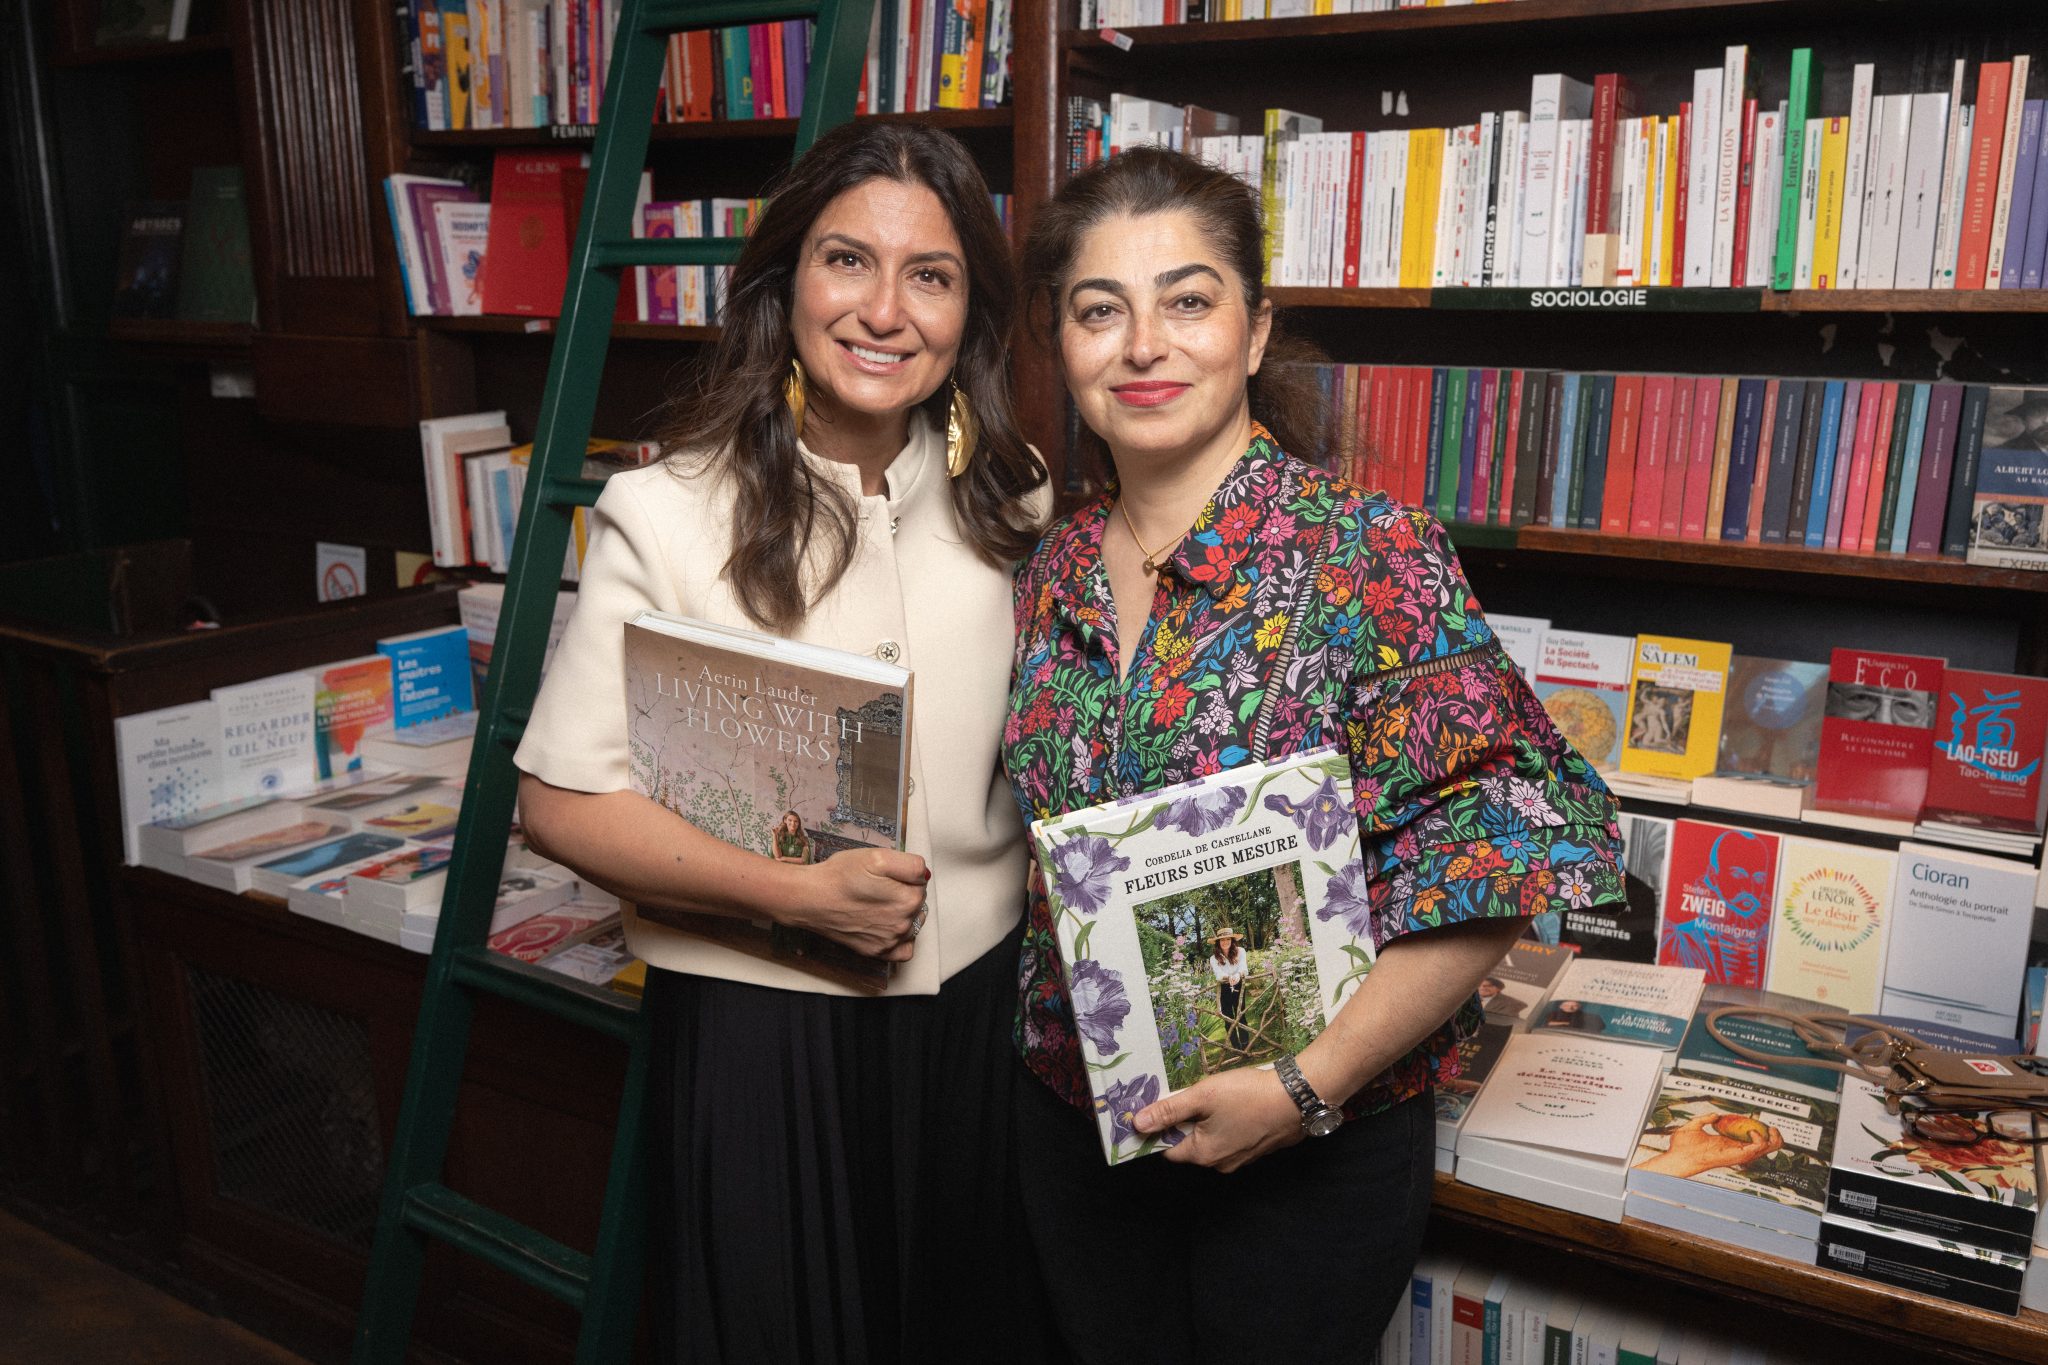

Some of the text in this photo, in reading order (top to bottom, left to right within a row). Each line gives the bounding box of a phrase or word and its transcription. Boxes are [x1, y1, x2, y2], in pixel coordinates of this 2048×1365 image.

[1788, 129, 1801, 149] soi
[1719, 128, 1735, 222] LA SÉDUCTION
[1785, 153, 1799, 189] Entre
[1530, 289, 1647, 308] SOCIOLOGIE
[1994, 464, 2035, 475] ALBERT
[1545, 647, 1590, 659] La Société
[1546, 637, 1558, 647] Guy
[398, 658, 418, 671] Les
[1543, 657, 1600, 671] du Spectacle
[1641, 649, 1697, 667] SALEM
[698, 664, 818, 706] Aerin Lauder
[1854, 657, 1917, 691] ECO
[656, 672, 864, 744] LIVING WITH
[224, 711, 311, 740] REGARDER
[686, 706, 831, 762] FLOWERS
[266, 731, 308, 750] NEUF
[1946, 741, 2019, 769] LAO-TSEU
[1959, 764, 1998, 780] Tao-te
[2000, 769, 2028, 787] king
[1144, 826, 1273, 868] CORDELIA DE CASTELLANE
[1124, 834, 1299, 895] FLEURS SUR MESURE
[1911, 861, 1969, 890] Cioran
[1681, 882, 1709, 897] Stefan
[1811, 890, 1856, 908] LENOIR
[1678, 893, 1726, 918] ZWEIG
[1804, 901, 1860, 924] Le désir
[1909, 887, 2010, 917] Anthologie du portrait
[1564, 920, 1631, 941] LES LIBERTÉS
[1565, 911, 1617, 930] ESSAI SUR
[1692, 916, 1756, 940] Montaigne
[1916, 1028, 1997, 1051] Comte-Sponville
[1516, 1071, 1624, 1091] démocratique
[1721, 1079, 1804, 1104] ETHAN MOLLICK
[1675, 1079, 1802, 1113] CO-INTELLIGENCE
[1576, 1336, 1585, 1352] Libre
